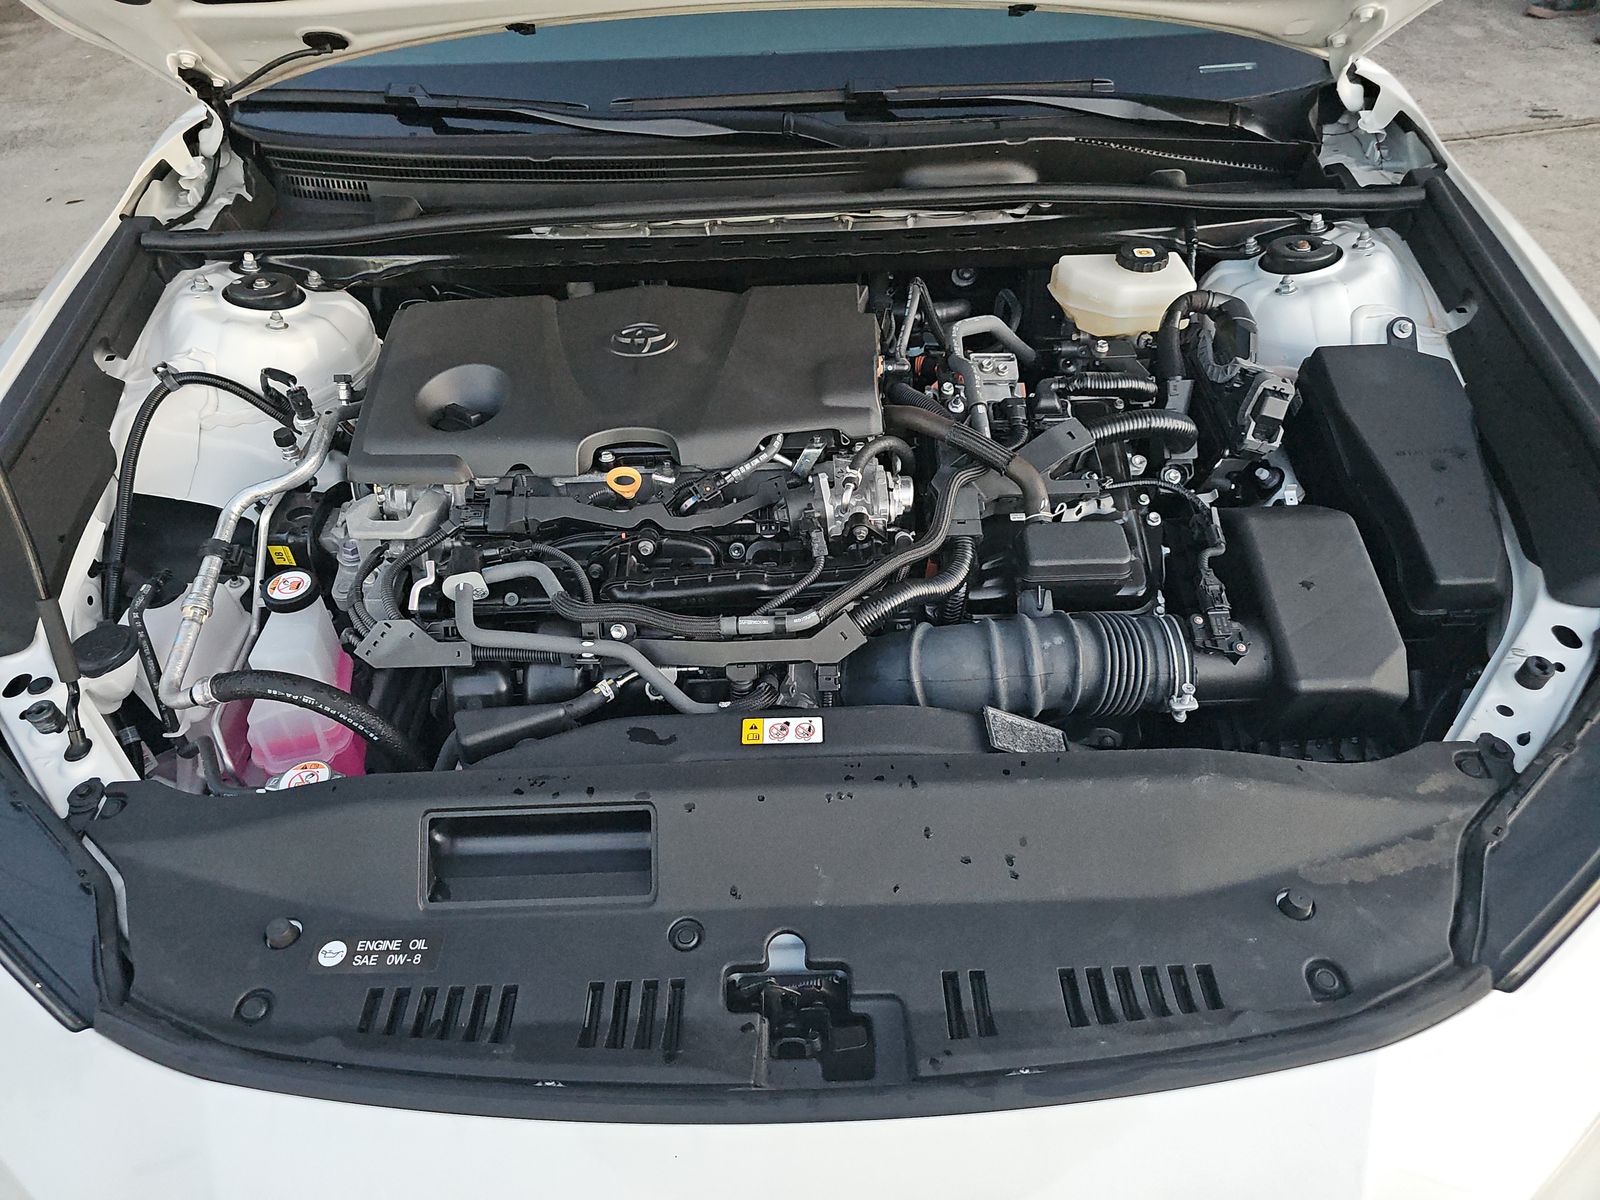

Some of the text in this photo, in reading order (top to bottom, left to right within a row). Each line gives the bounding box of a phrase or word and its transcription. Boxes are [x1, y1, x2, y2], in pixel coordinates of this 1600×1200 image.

[356, 939, 428, 952] ENGINE OIL
[352, 953, 422, 966] SAE 0W-8
